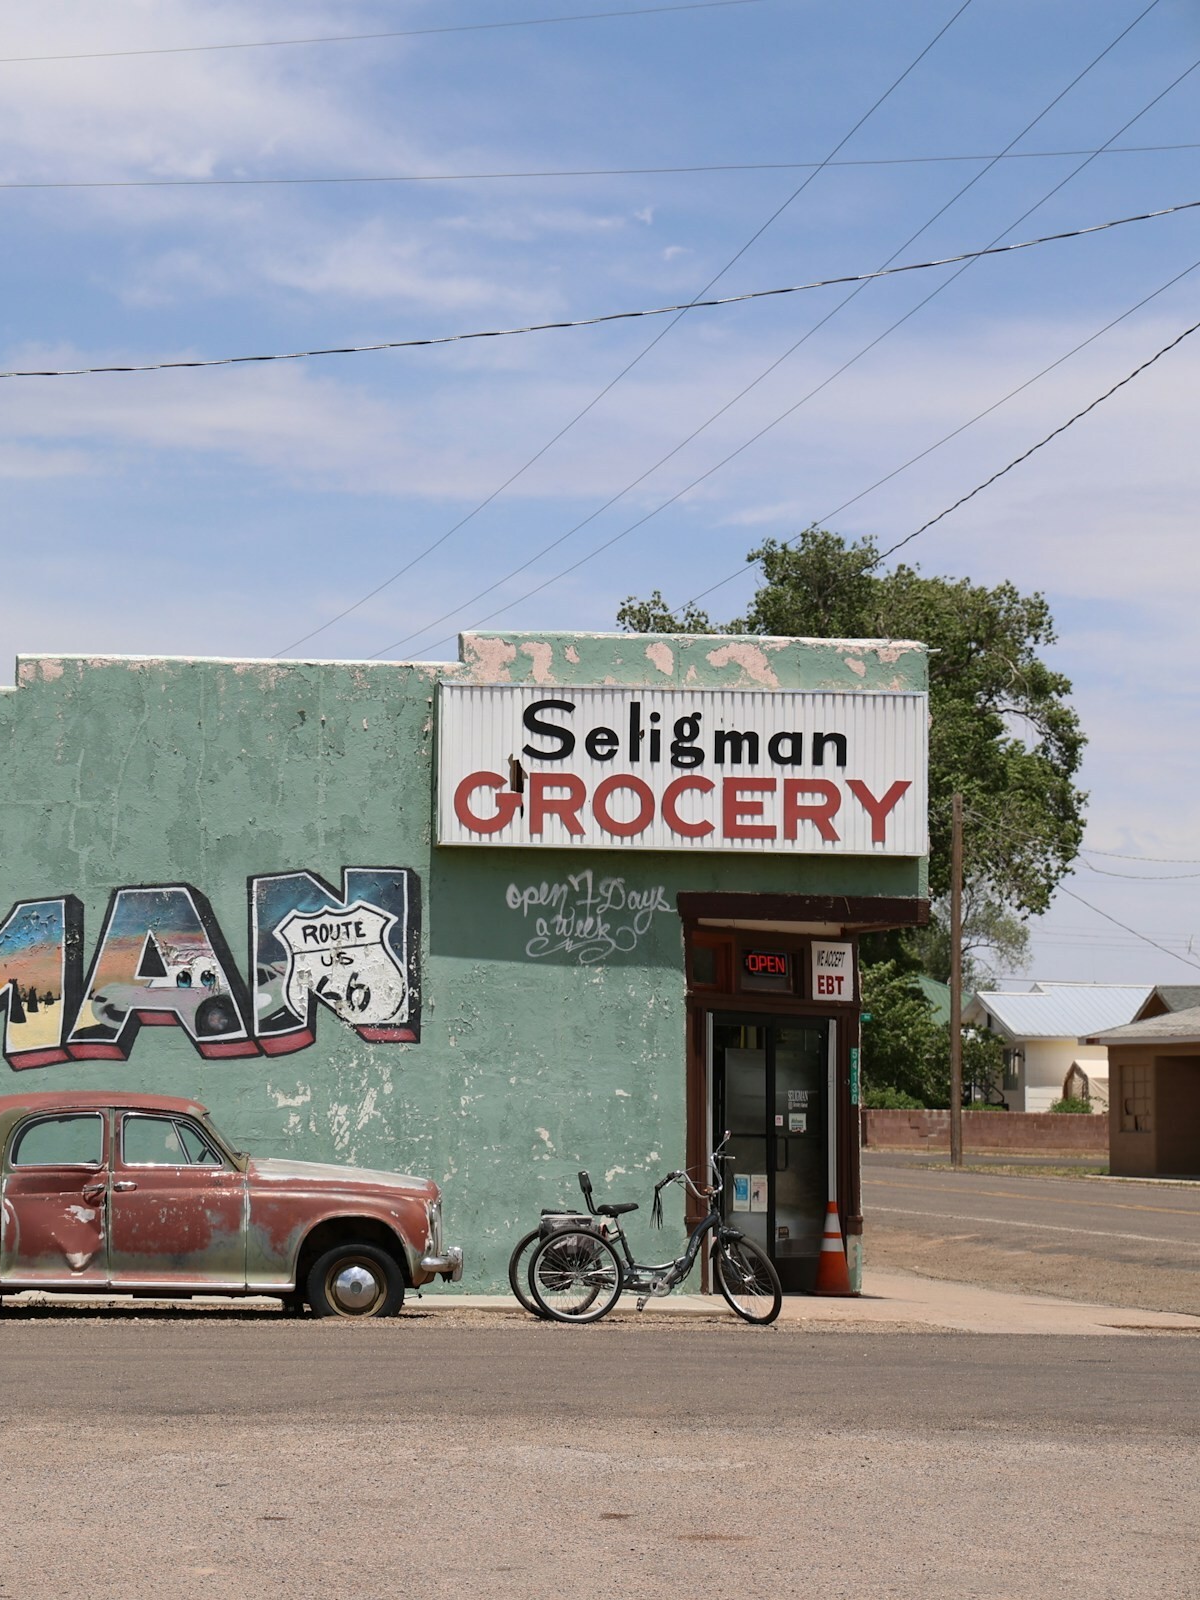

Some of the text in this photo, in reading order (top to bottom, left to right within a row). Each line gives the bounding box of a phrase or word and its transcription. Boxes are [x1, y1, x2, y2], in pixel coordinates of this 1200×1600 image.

[522, 699, 848, 769] Seligman
[453, 770, 913, 843] GROCERY
[567, 869, 601, 917] 7
[596, 877, 678, 935] Days
[301, 921, 367, 945] ROUTE
[320, 952, 354, 967] US
[747, 954, 786, 974] OPEN
[816, 950, 846, 968] WE ACCEPT
[817, 974, 845, 996] EBT
[851, 1048, 859, 1105] 54130
